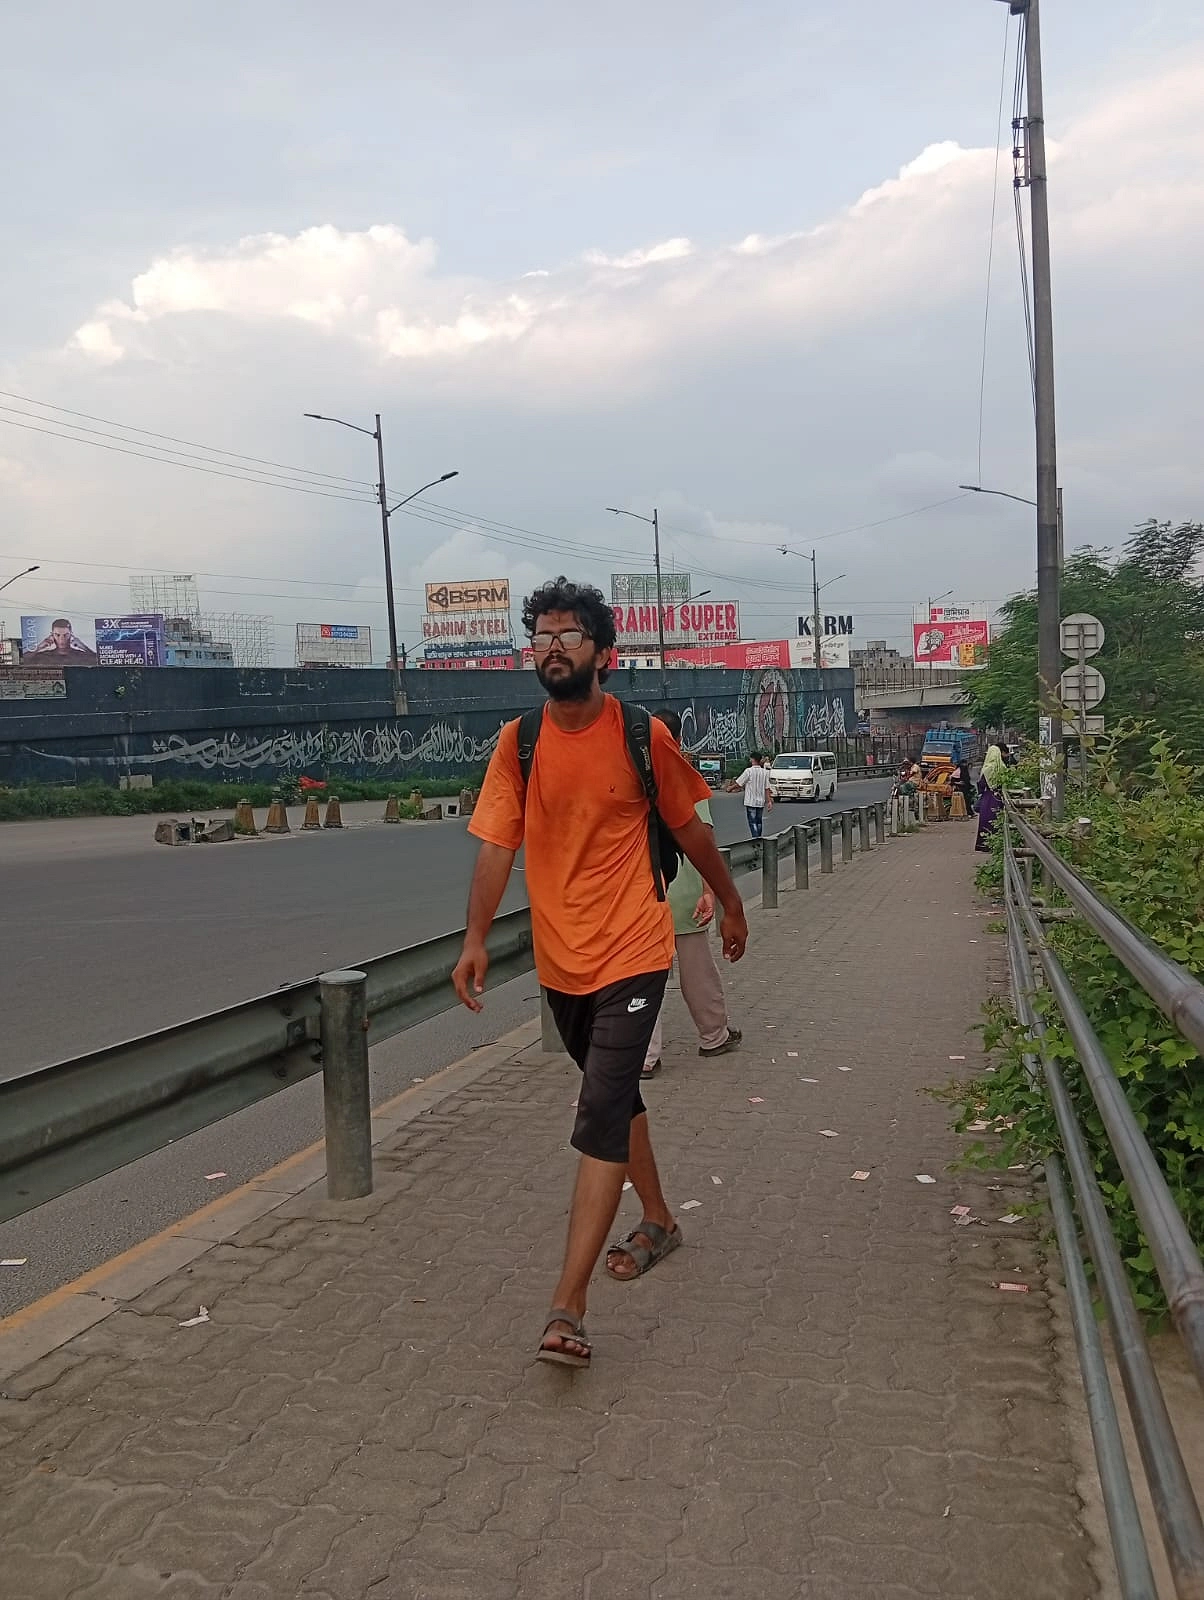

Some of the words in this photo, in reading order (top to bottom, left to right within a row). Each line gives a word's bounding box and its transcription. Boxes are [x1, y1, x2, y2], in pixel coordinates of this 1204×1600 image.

[450, 588, 507, 603] BSRM
[613, 606, 674, 633] RAHIM
[680, 604, 736, 631] SUPER
[27, 618, 38, 652] CLEAR
[423, 621, 466, 637] RAHIM
[470, 619, 507, 636] STEEL
[698, 631, 737, 641] EXTREME
[124, 657, 144, 665] HEAD
[630, 998, 647, 1007] NIKE
